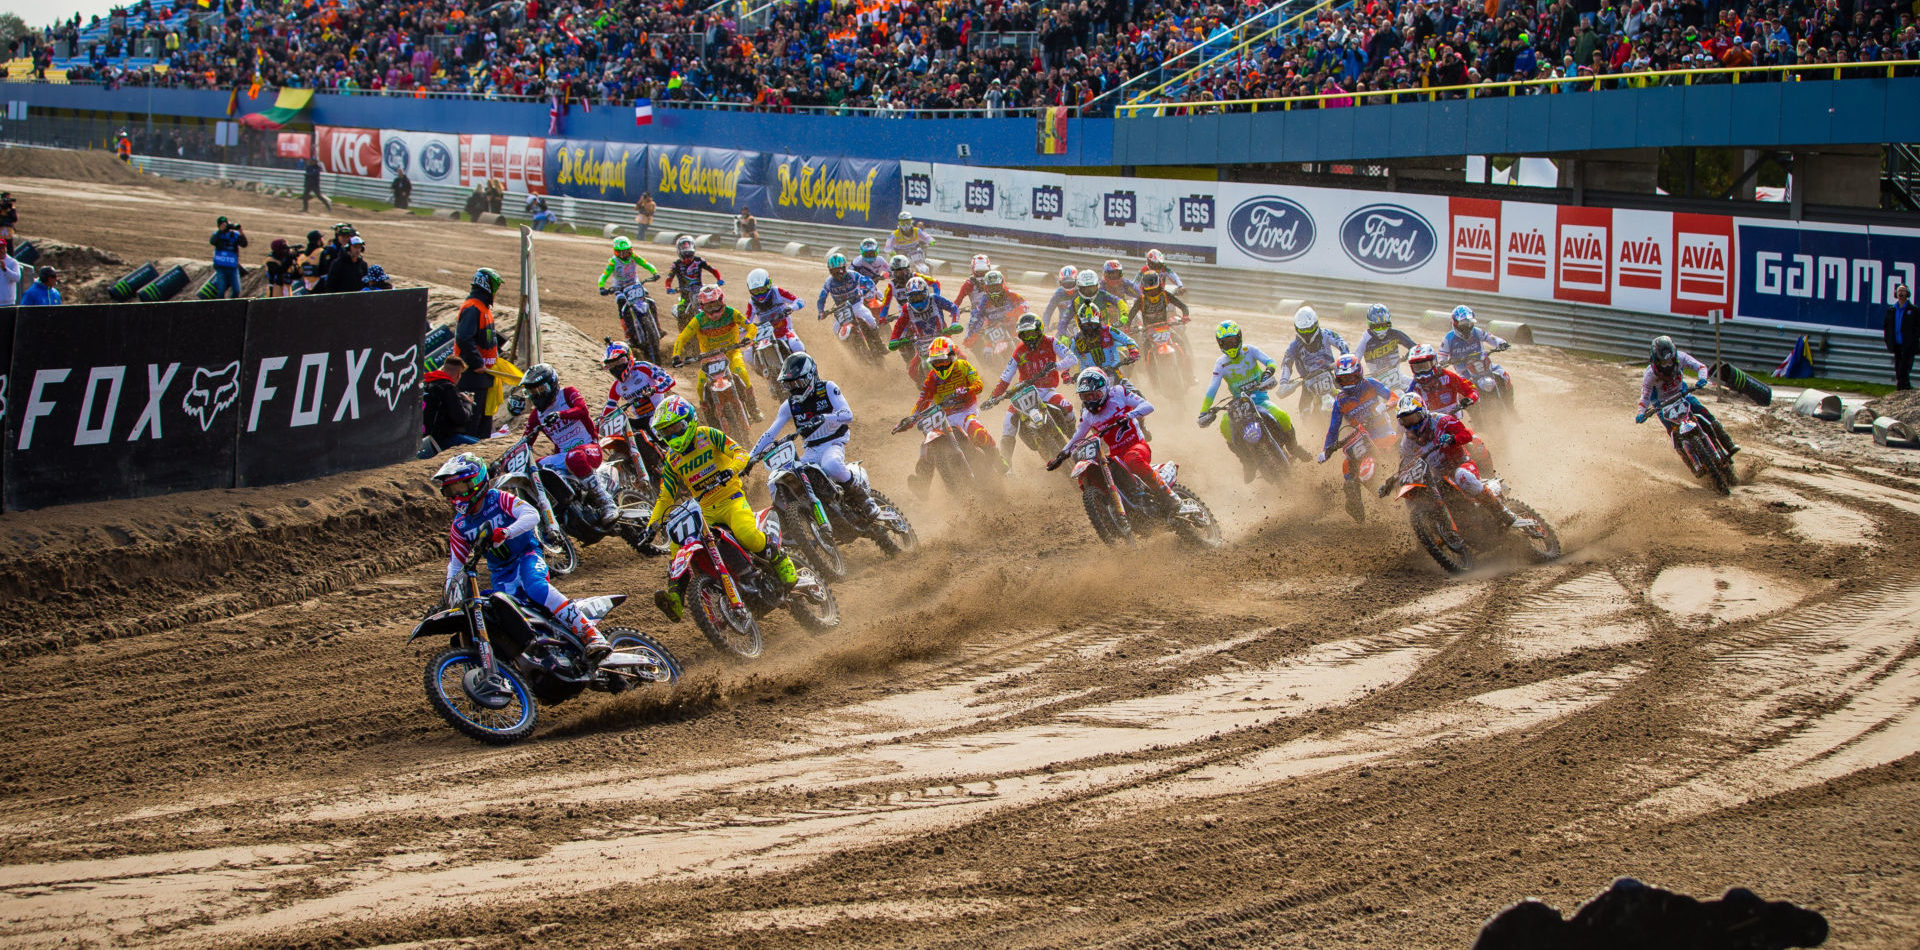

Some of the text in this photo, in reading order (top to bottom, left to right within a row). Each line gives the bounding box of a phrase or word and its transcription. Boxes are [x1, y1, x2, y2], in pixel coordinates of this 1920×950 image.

[331, 132, 371, 175] KFC
[557, 147, 629, 195] De Telegraaf
[659, 153, 745, 207] De Telegraaf
[777, 163, 877, 221] De Telegraaf
[907, 179, 928, 200] ESS
[968, 186, 990, 207] ESS
[1035, 191, 1059, 214] ESS
[1107, 197, 1132, 219] ESS
[1184, 202, 1210, 224] ESS
[1244, 205, 1299, 251] Ford
[1358, 213, 1418, 263] Ford
[246, 347, 372, 433] FOX
[17, 361, 181, 451] FOX
[603, 412, 627, 437] 119
[921, 410, 944, 433] 20
[507, 450, 526, 475] 98
[678, 449, 713, 476] THOR
[768, 445, 793, 470] 50
[672, 515, 697, 543] 11
